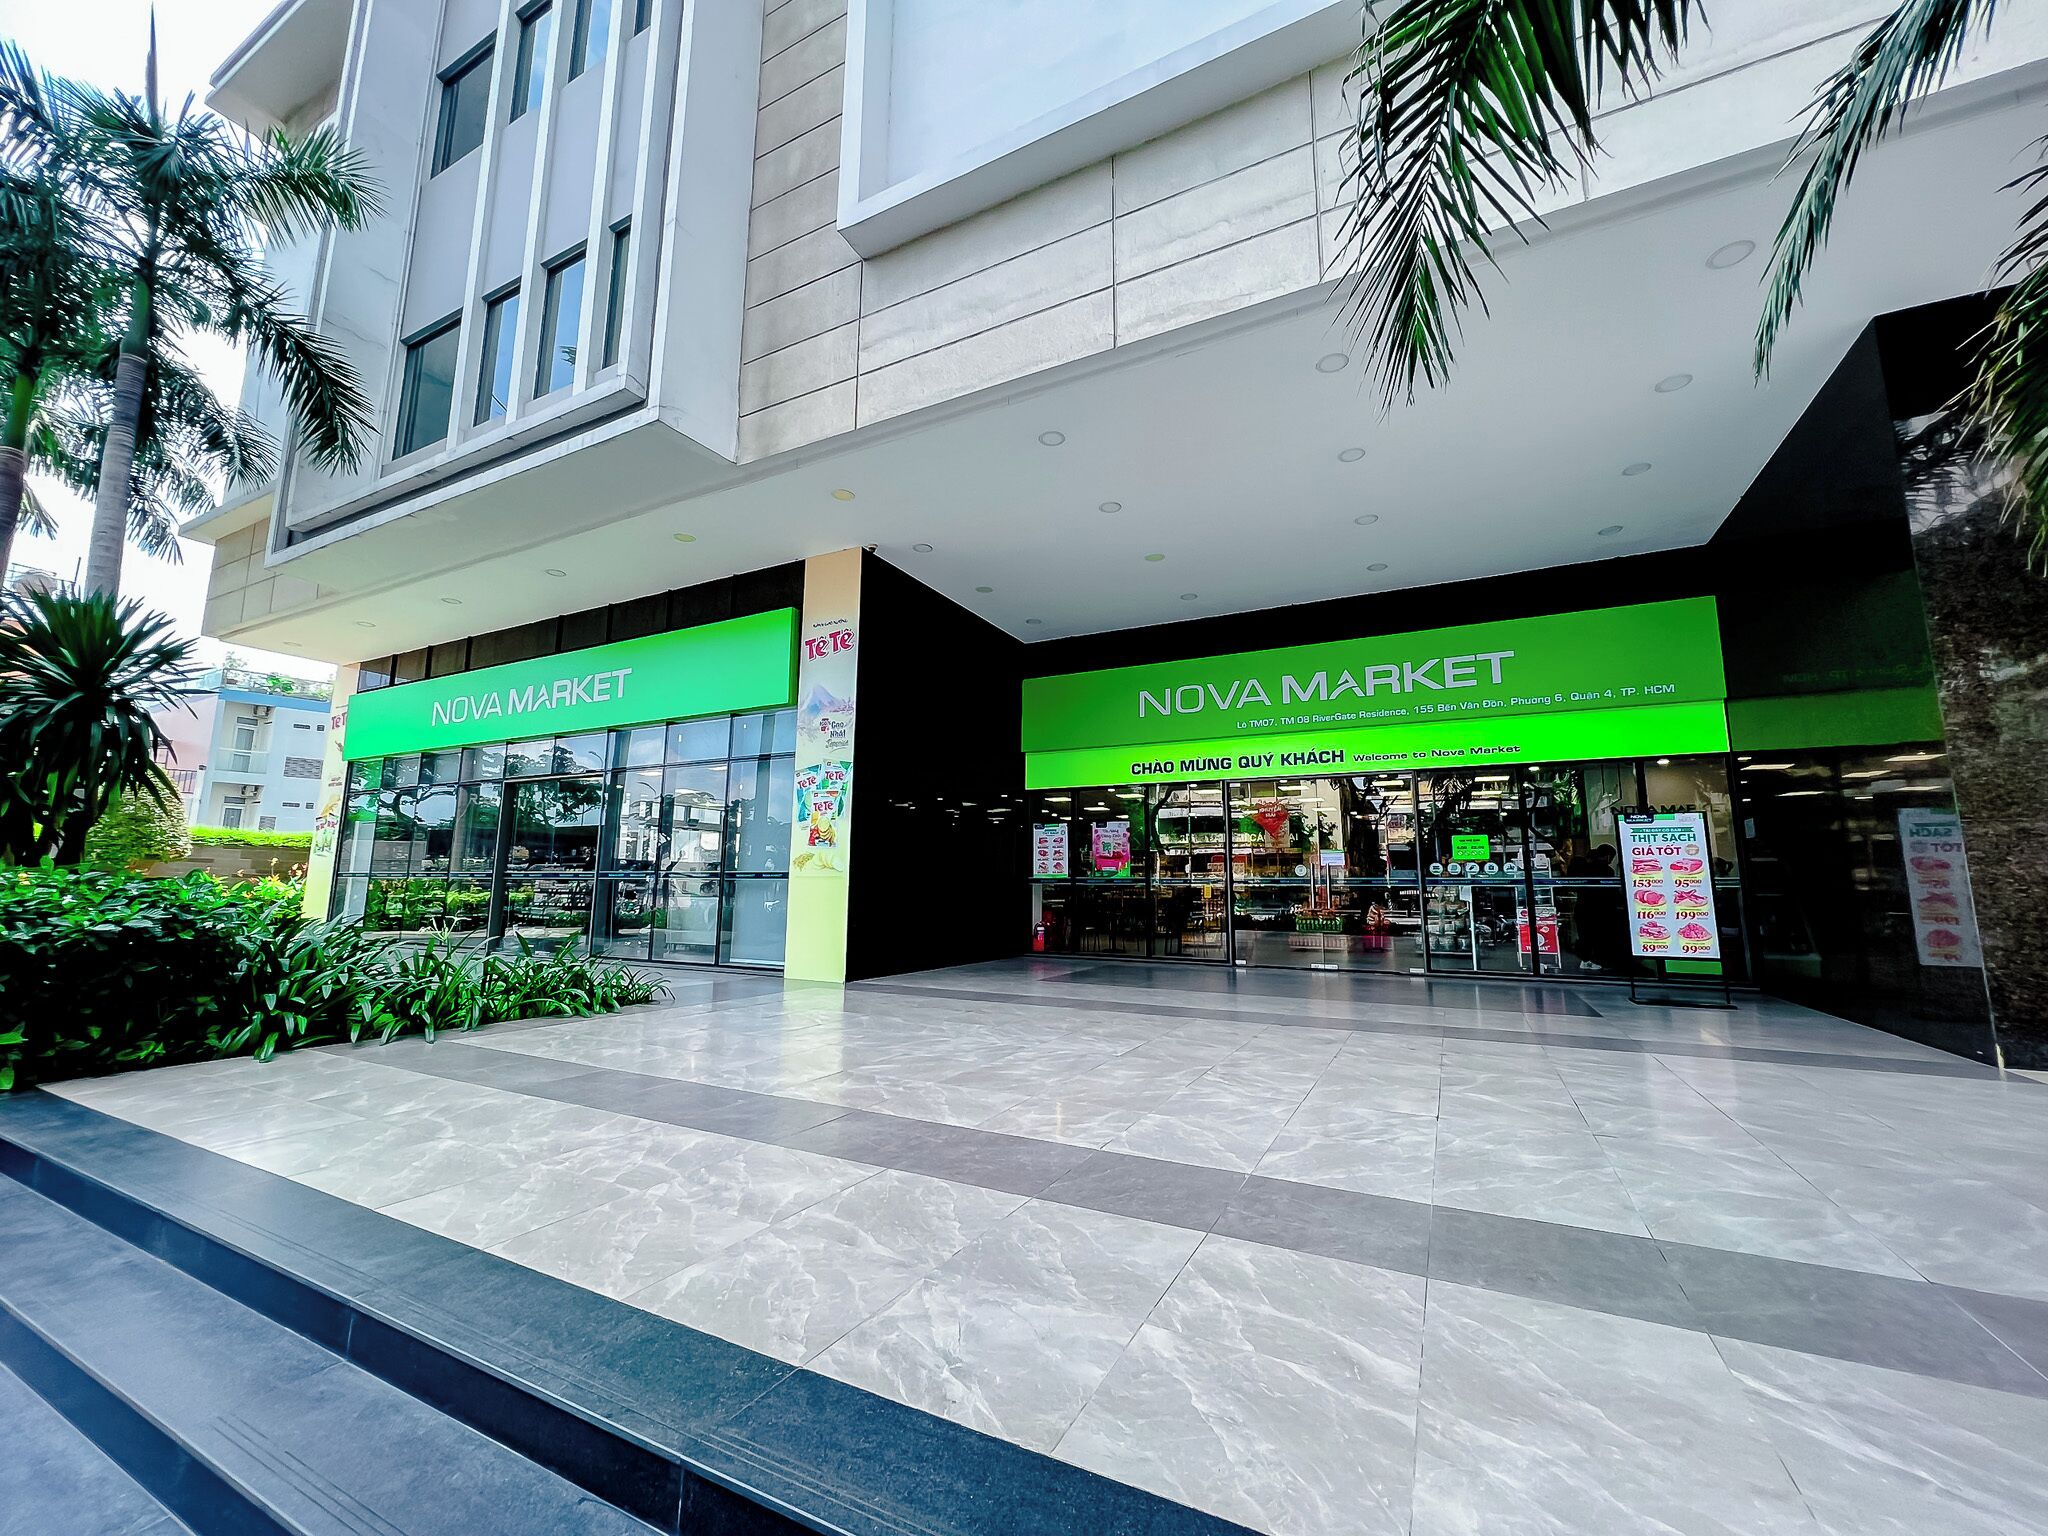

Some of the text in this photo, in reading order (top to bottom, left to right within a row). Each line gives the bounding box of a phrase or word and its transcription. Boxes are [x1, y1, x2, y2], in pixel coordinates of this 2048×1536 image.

[431, 667, 633, 727] NOVA MARKET
[1139, 650, 1515, 718] NOVA MARKET
[1280, 716, 1296, 726] TM
[1297, 715, 1310, 724] 08
[1312, 711, 1357, 724] RiverGate
[1413, 704, 1435, 715] 155
[1644, 684, 1676, 695] HCM
[1131, 748, 1345, 775] CHÀO MỪNG QUÝ KHÁCH
[1353, 745, 1521, 762] Welcome to Nova Market
[1630, 833, 1697, 845] THỊT SẠCH
[1631, 844, 1682, 856] GIÁ TỐT
